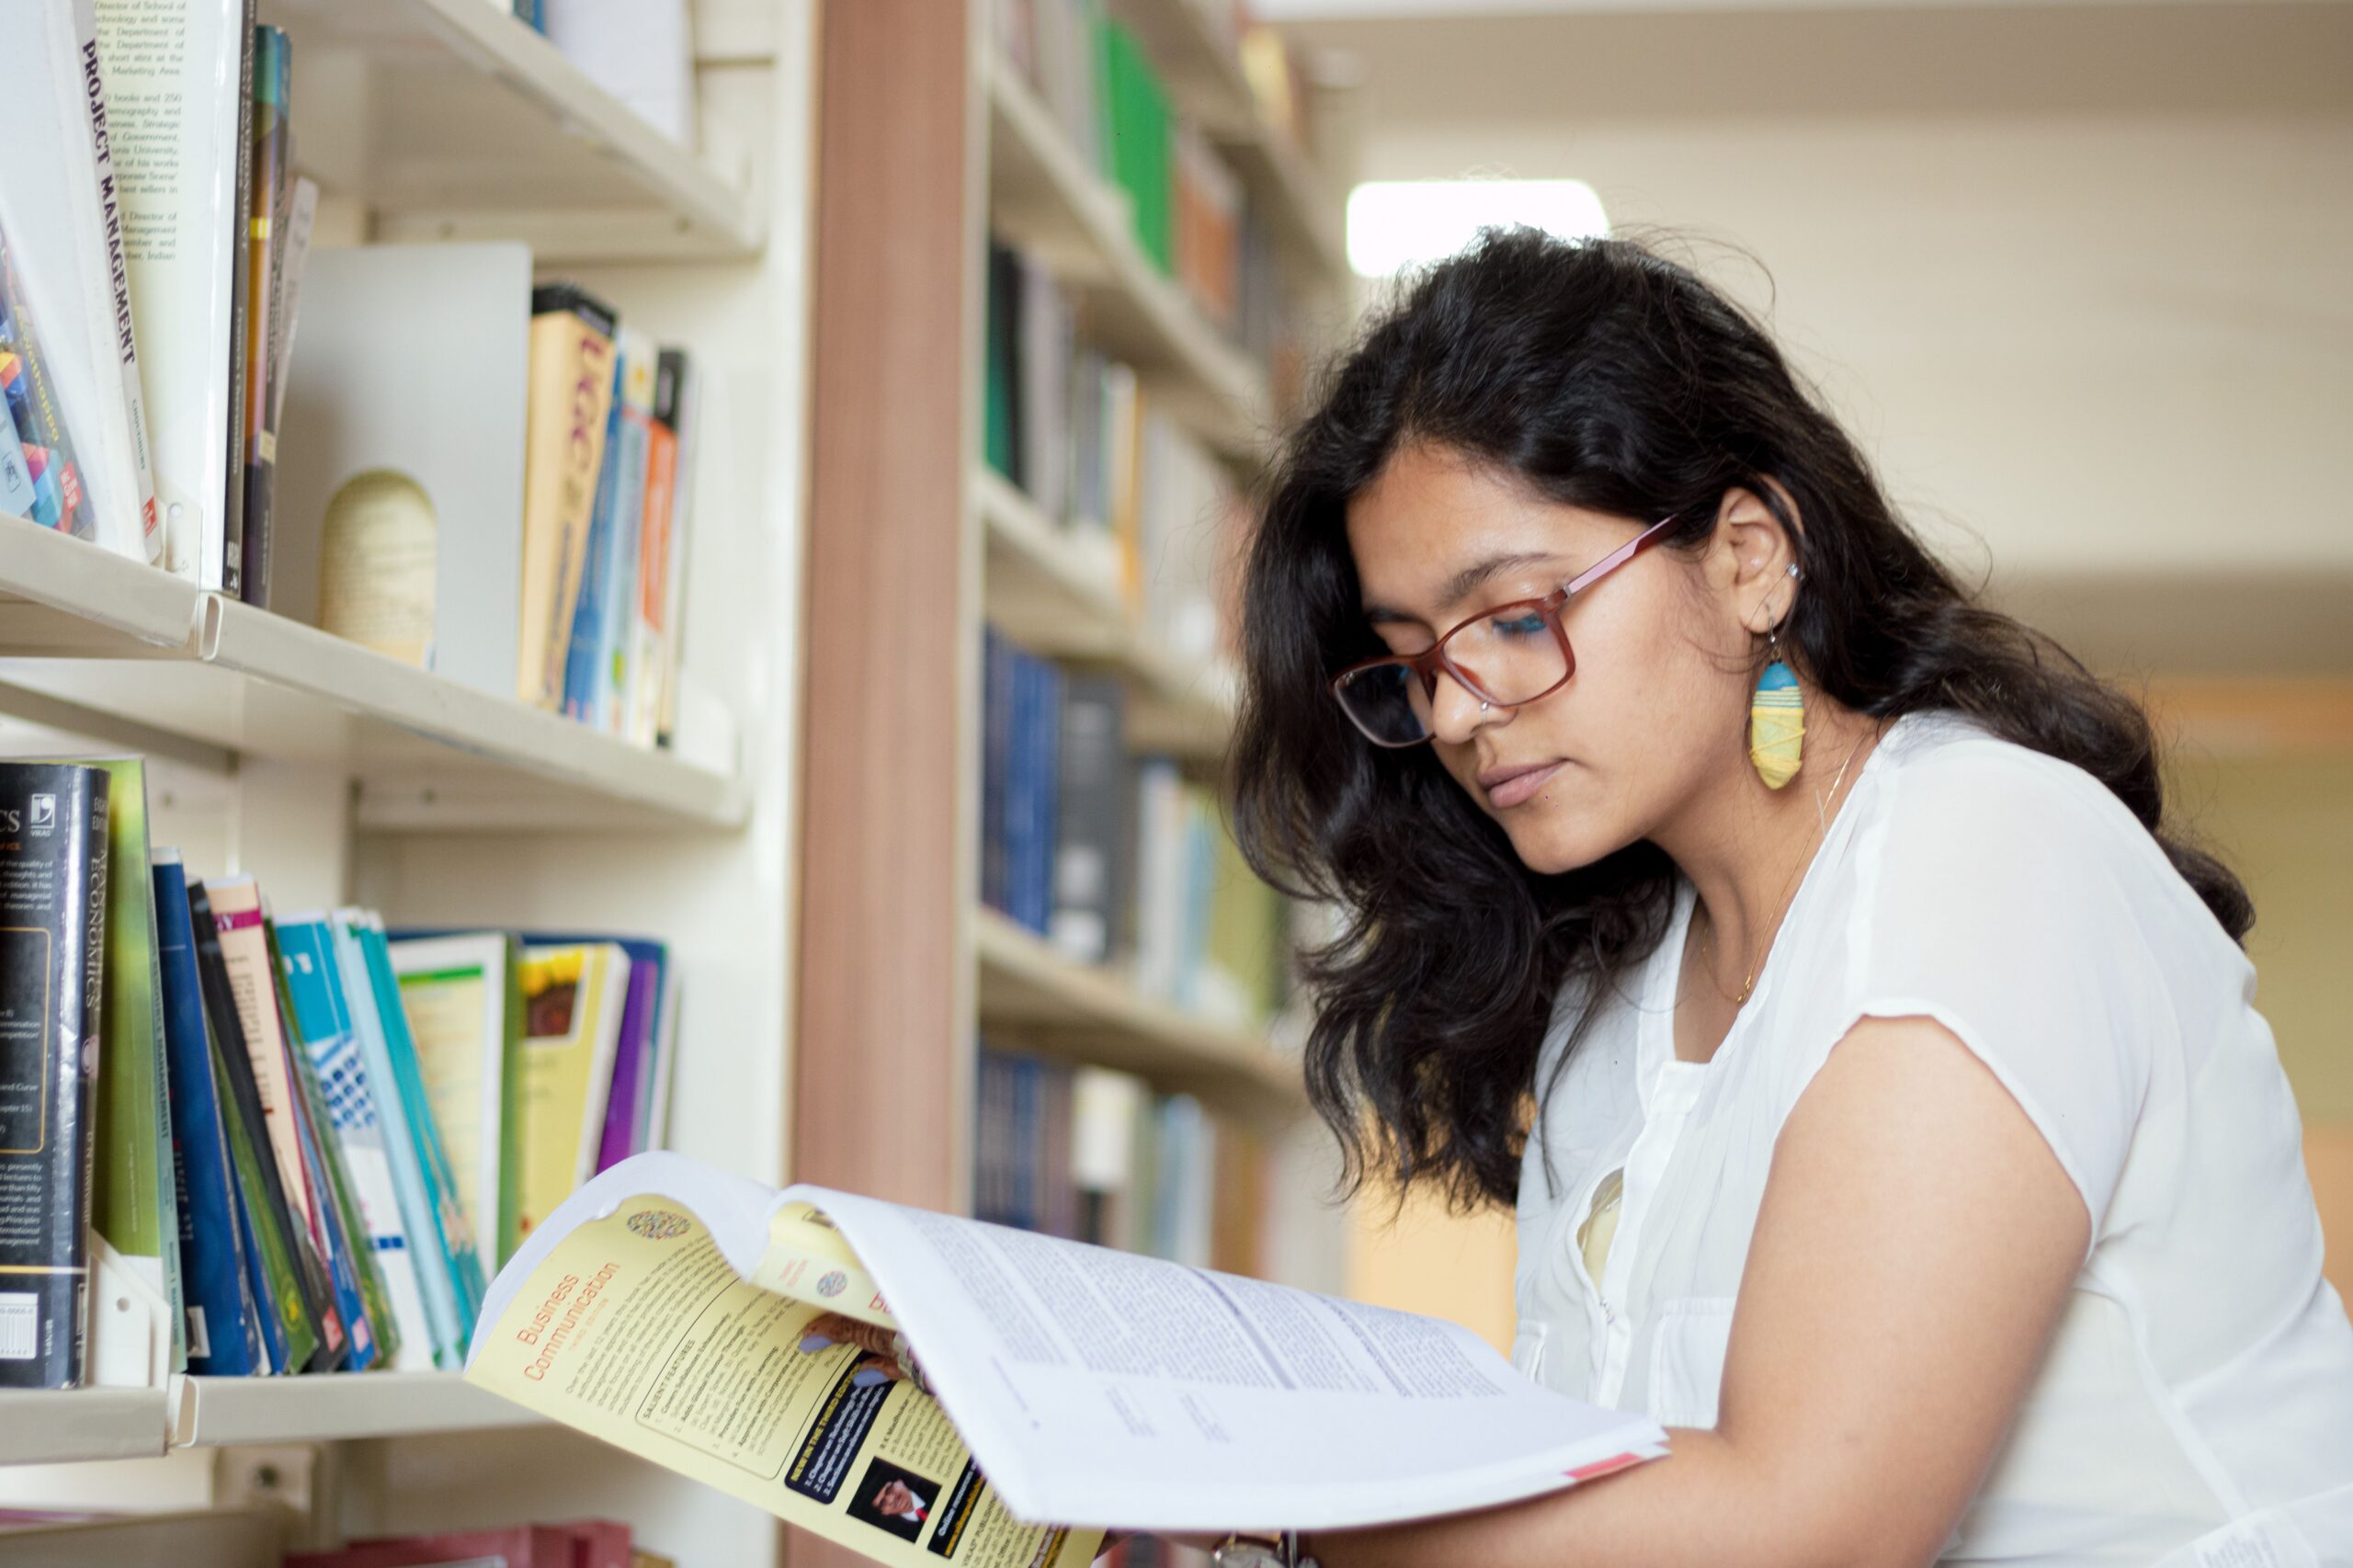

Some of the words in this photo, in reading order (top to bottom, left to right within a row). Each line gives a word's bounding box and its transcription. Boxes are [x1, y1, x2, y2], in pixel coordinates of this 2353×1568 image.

[83, 38, 110, 165] PROJECT
[101, 173, 135, 365] MANAGEMENT
[132, 398, 147, 472] CHOUDHURY
[30, 829, 51, 837] VIKAS
[85, 855, 101, 1008] ECONOMICS
[154, 1035, 170, 1139] MANAGEMENT
[517, 1274, 579, 1346] Business
[524, 1262, 620, 1381] Communication
[586, 1354, 618, 1402] management
[608, 1358, 642, 1411] understanding
[642, 1381, 665, 1419] SALIENT
[665, 1339, 696, 1381] FEATURES
[661, 1389, 678, 1414] Covers
[675, 1353, 701, 1389] Syllabuses
[680, 1403, 694, 1422] Adds
[691, 1380, 709, 1403] Global
[705, 1353, 724, 1379] Flavour
[718, 1407, 740, 1438] Provides
[735, 1392, 748, 1407] Fun
[745, 1377, 756, 1392] with
[738, 1415, 758, 1448] Apprises
[756, 1398, 767, 1415] with
[765, 1363, 790, 1399] Corporate
[790, 1456, 808, 1482] NEW
[802, 1445, 813, 1458] IN
[808, 1426, 824, 1445] THE
[818, 1397, 839, 1426] THIRD
[808, 1449, 827, 1480] Chapter
[828, 1399, 855, 1439] Technology
[817, 1452, 837, 1484] Chapter
[837, 1428, 849, 1445] Soft
[845, 1409, 860, 1431] Skills
[886, 1398, 910, 1436] Madhukar
[826, 1457, 847, 1489] Sections
[848, 1422, 865, 1449] eleven
[938, 1507, 956, 1537] Online
[952, 1465, 977, 1508] resources
